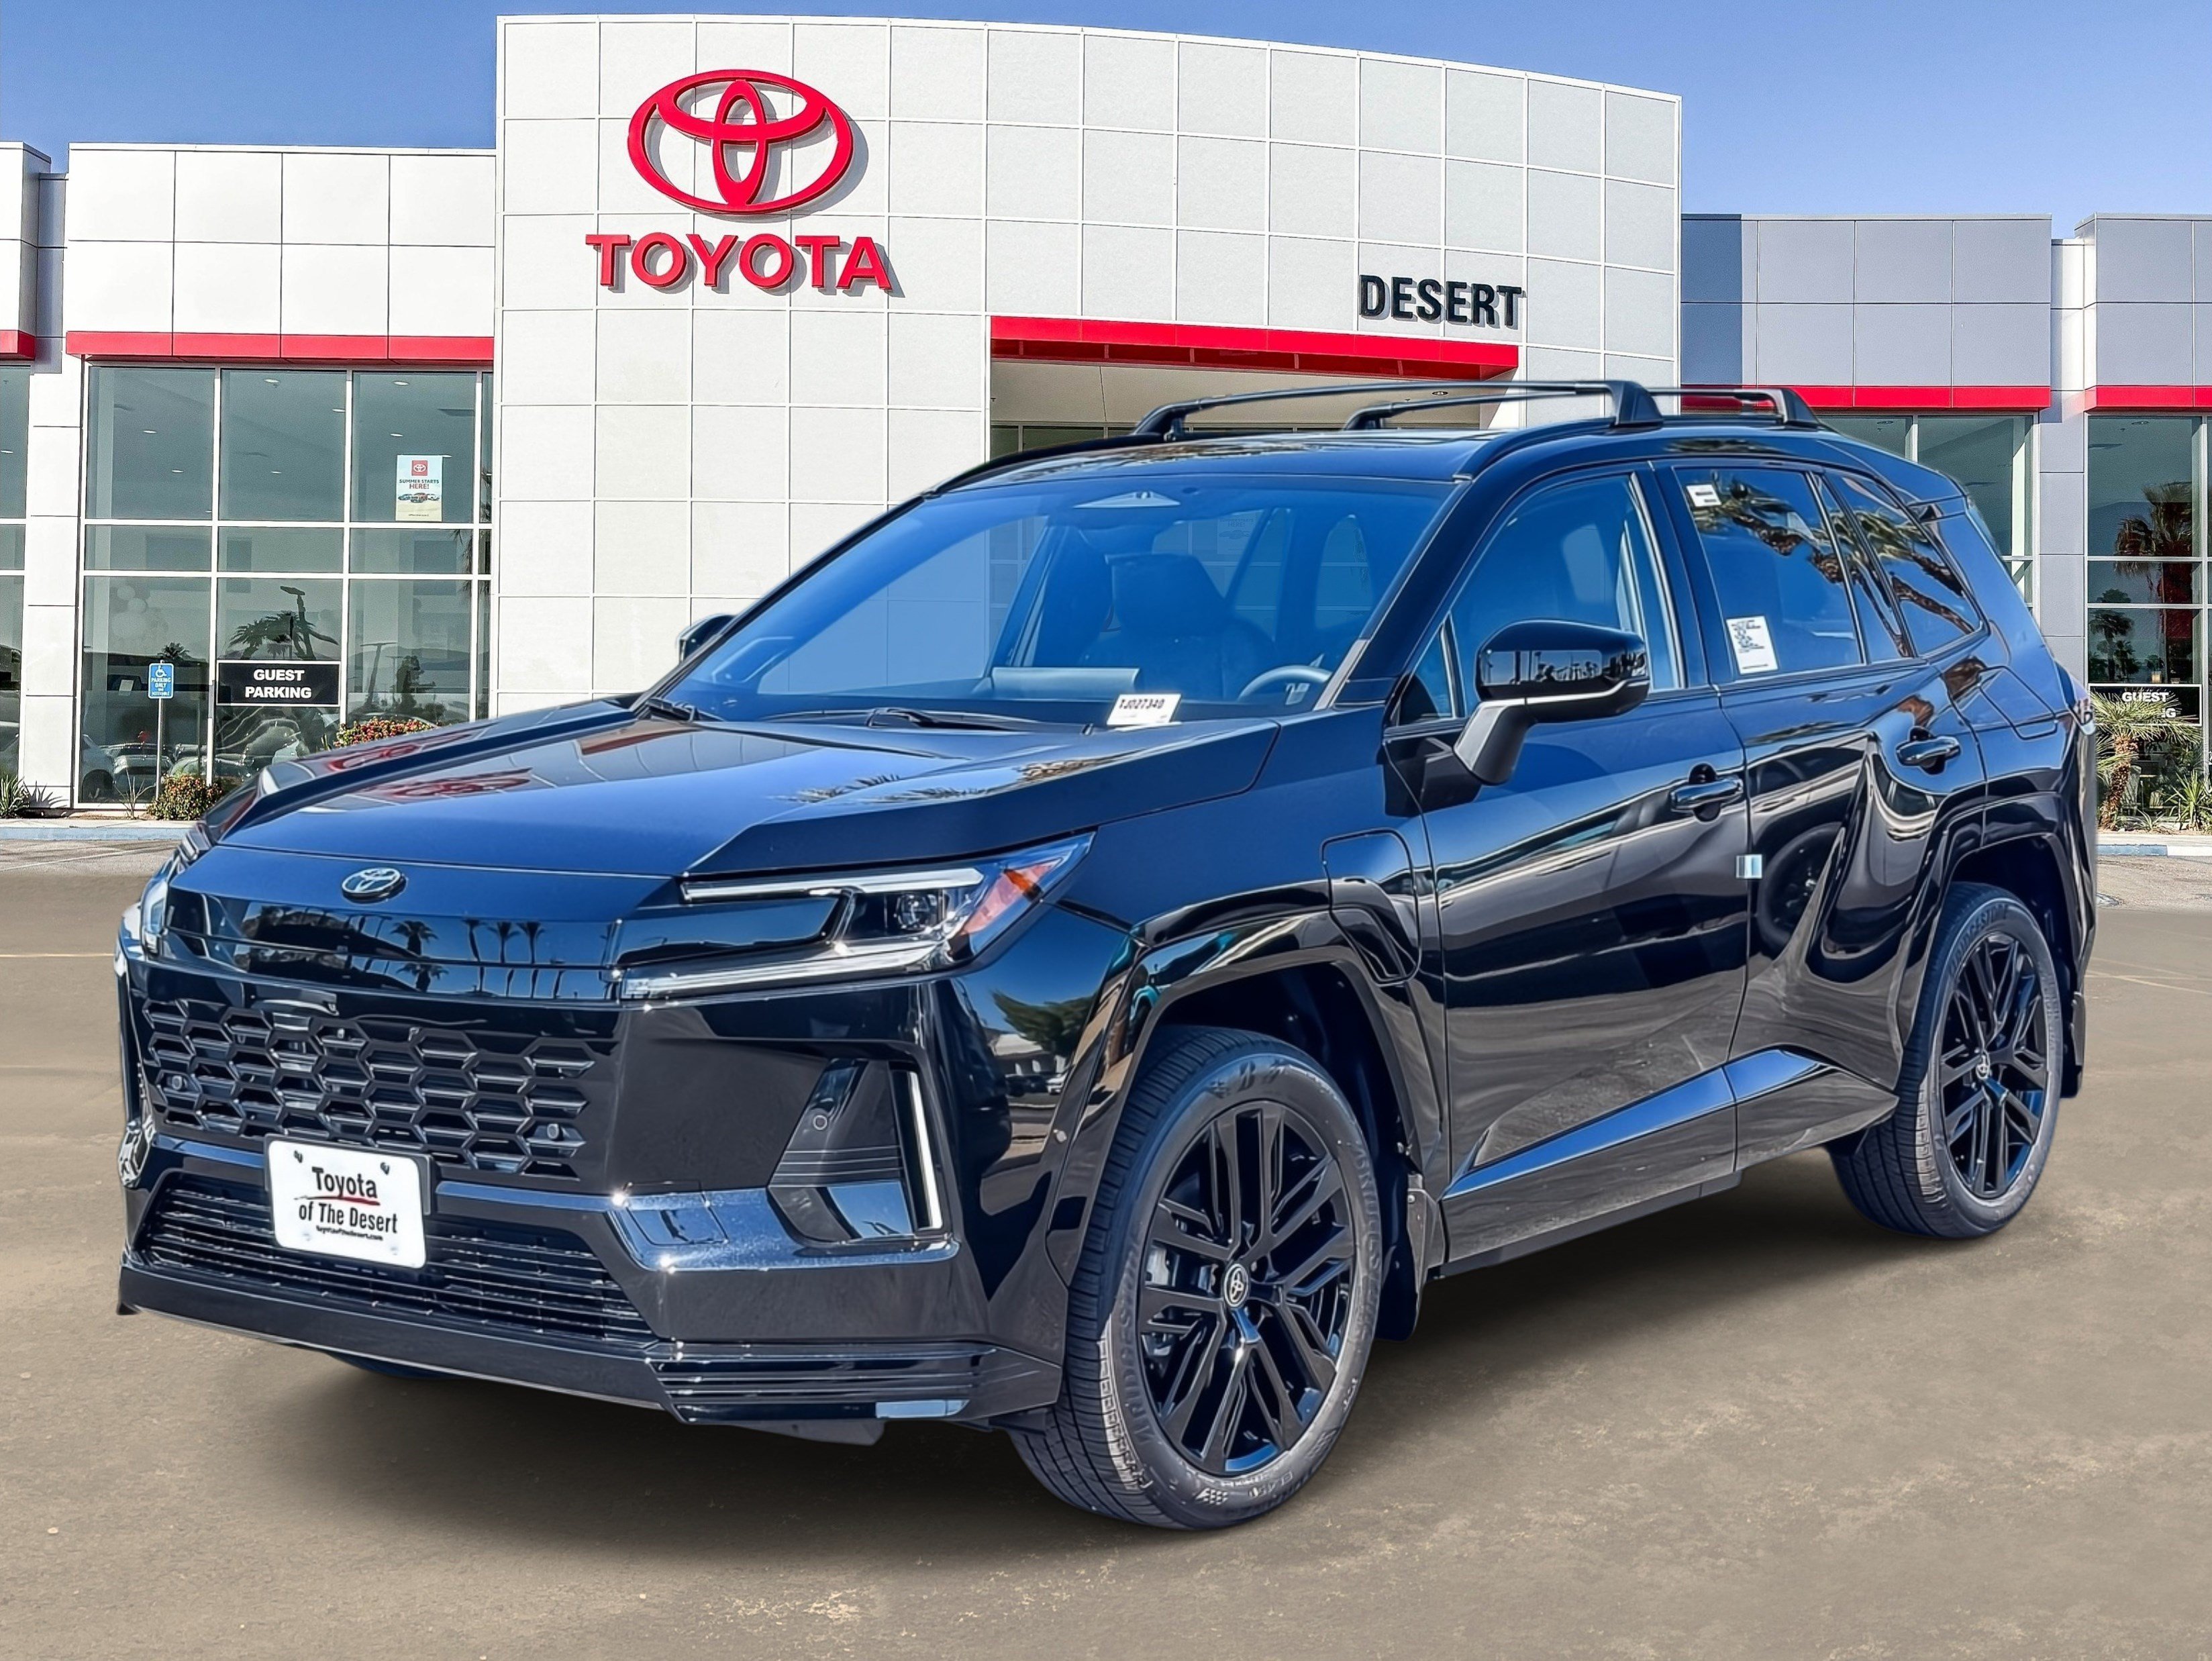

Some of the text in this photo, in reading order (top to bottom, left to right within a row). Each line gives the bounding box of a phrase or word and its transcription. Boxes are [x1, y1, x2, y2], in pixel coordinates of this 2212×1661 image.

[585, 232, 893, 290] TOYOTA
[1359, 274, 1522, 327] DESERT
[253, 669, 305, 681] GUEST
[245, 686, 312, 699] PARKING
[2121, 691, 2169, 702] GUEST
[311, 1166, 378, 1199] Toyota
[299, 1201, 398, 1234] of The Desert
